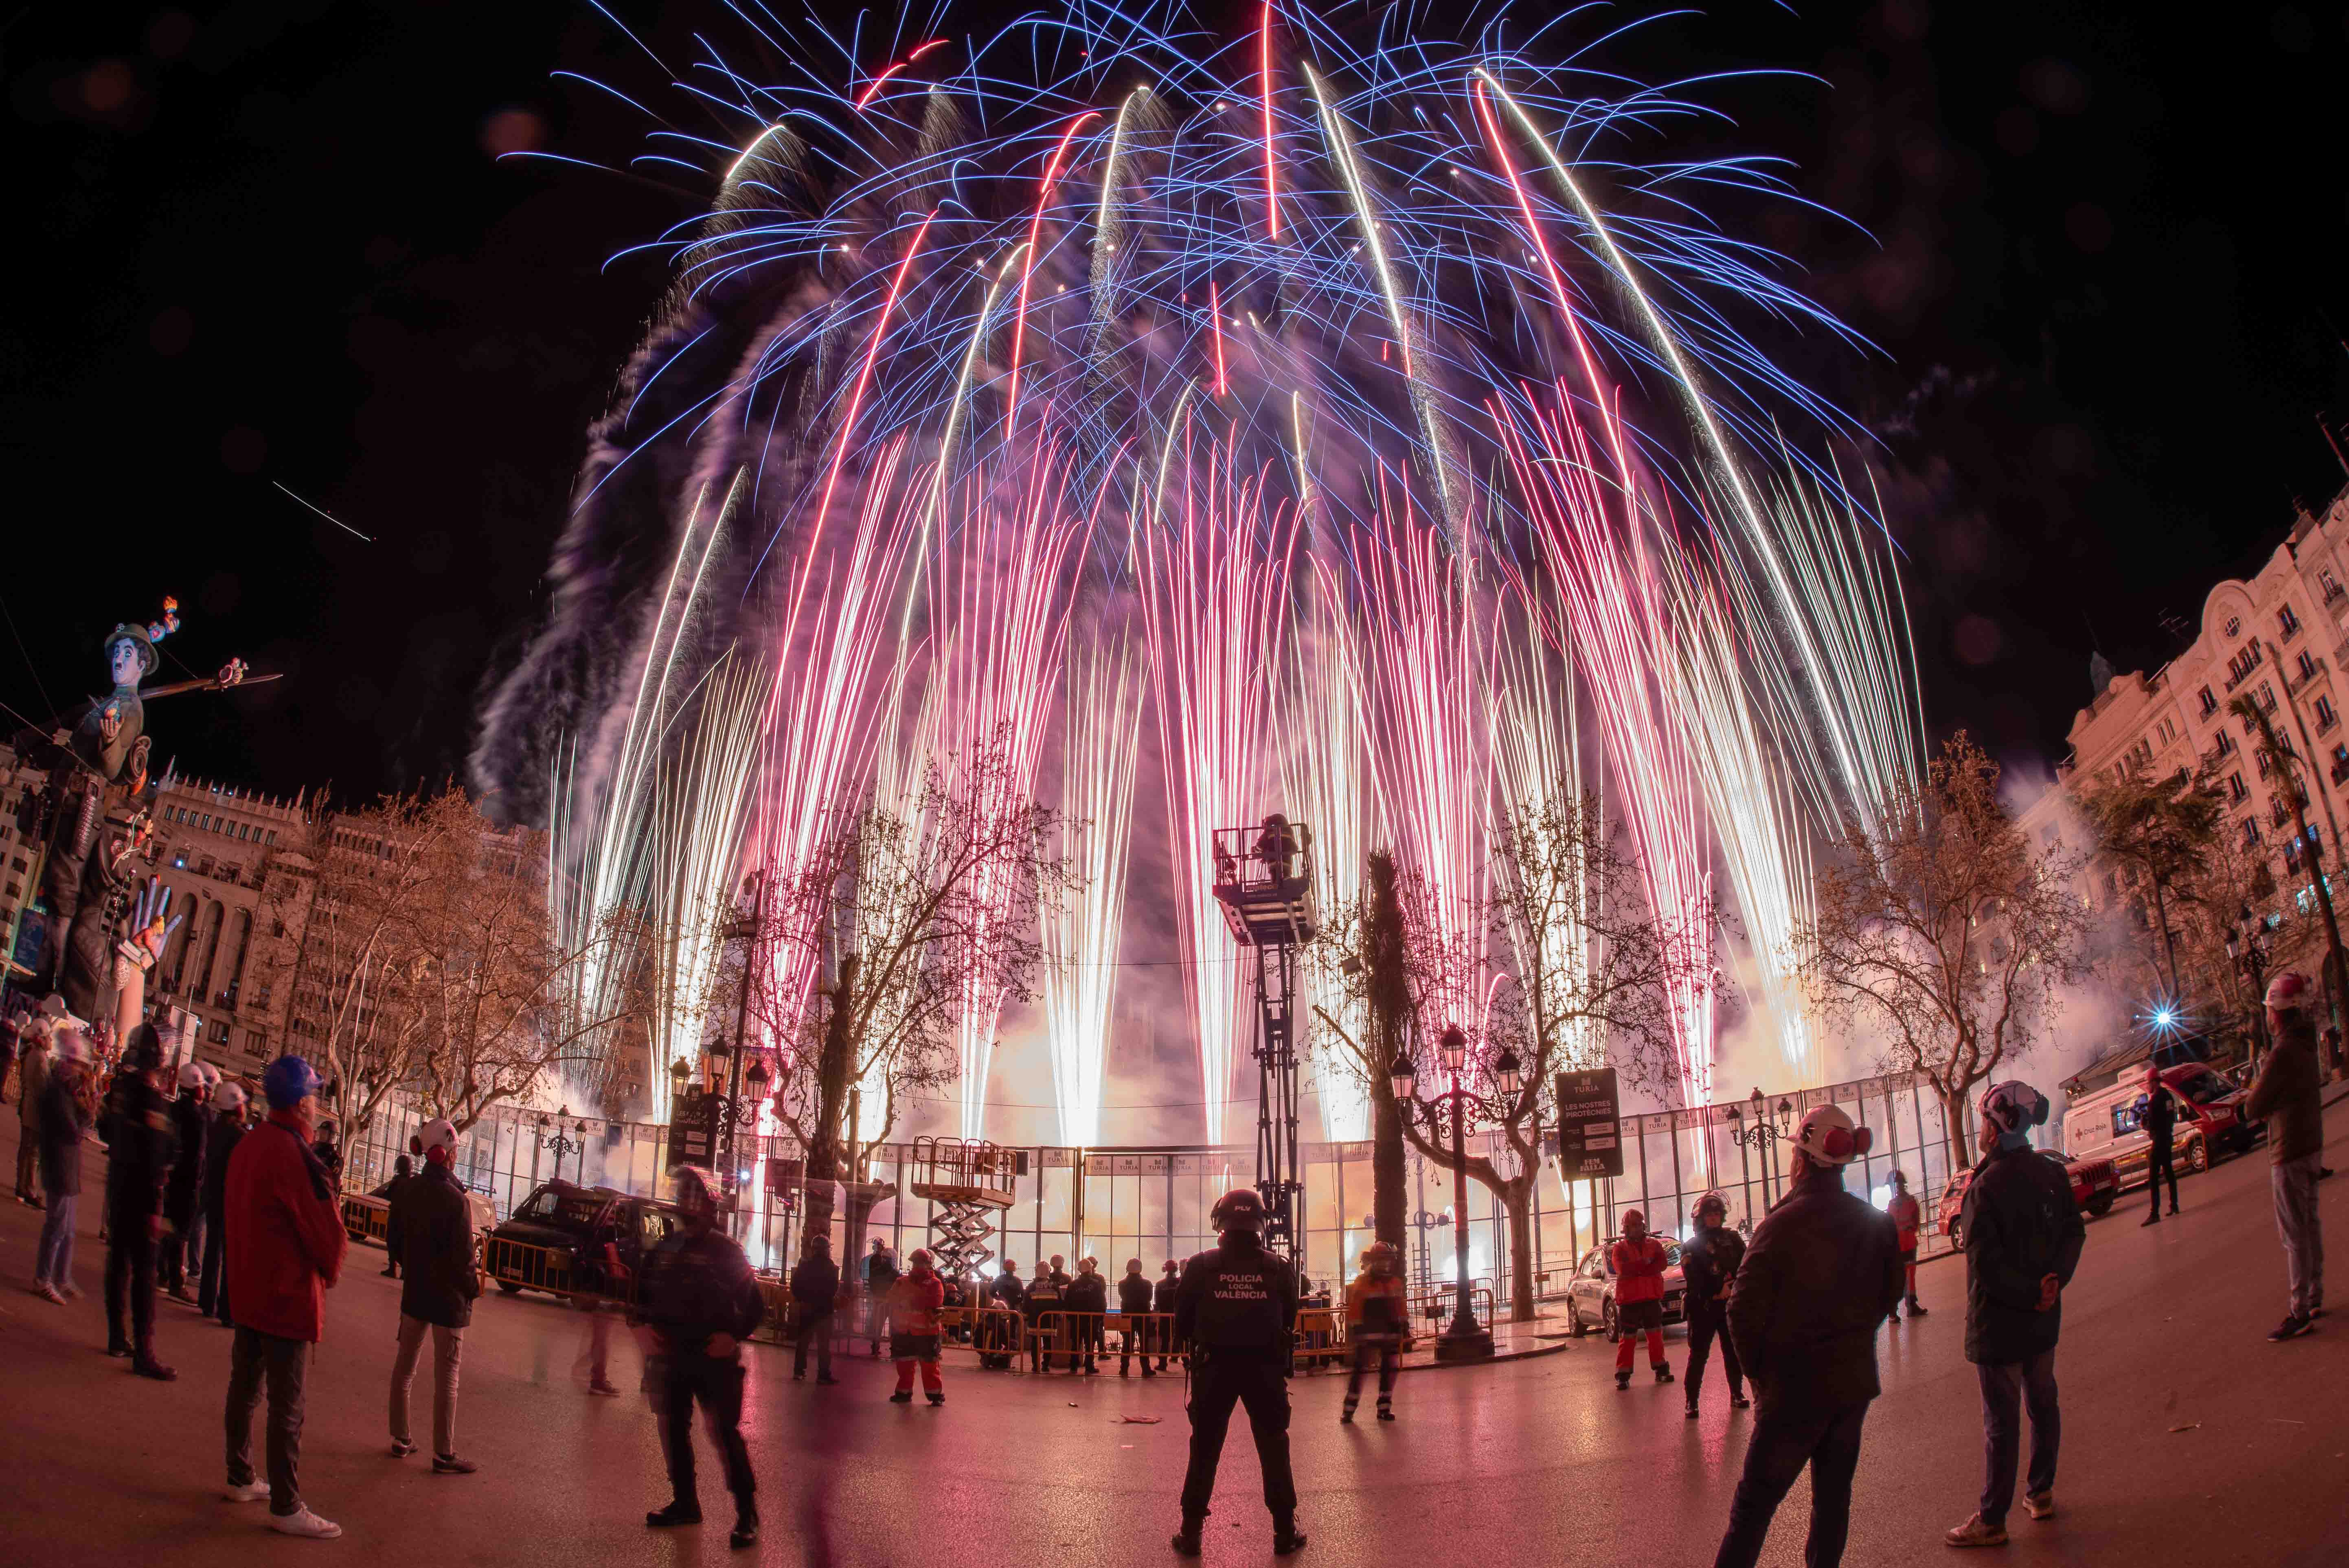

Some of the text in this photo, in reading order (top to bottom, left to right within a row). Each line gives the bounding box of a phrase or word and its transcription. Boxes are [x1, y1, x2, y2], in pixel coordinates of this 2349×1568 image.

[1574, 1085, 1599, 1093] TURIA
[1579, 1100, 1611, 1109] NOSTRES
[2095, 1123, 2106, 1131] Roja
[1219, 1274, 1263, 1282] POLICIA
